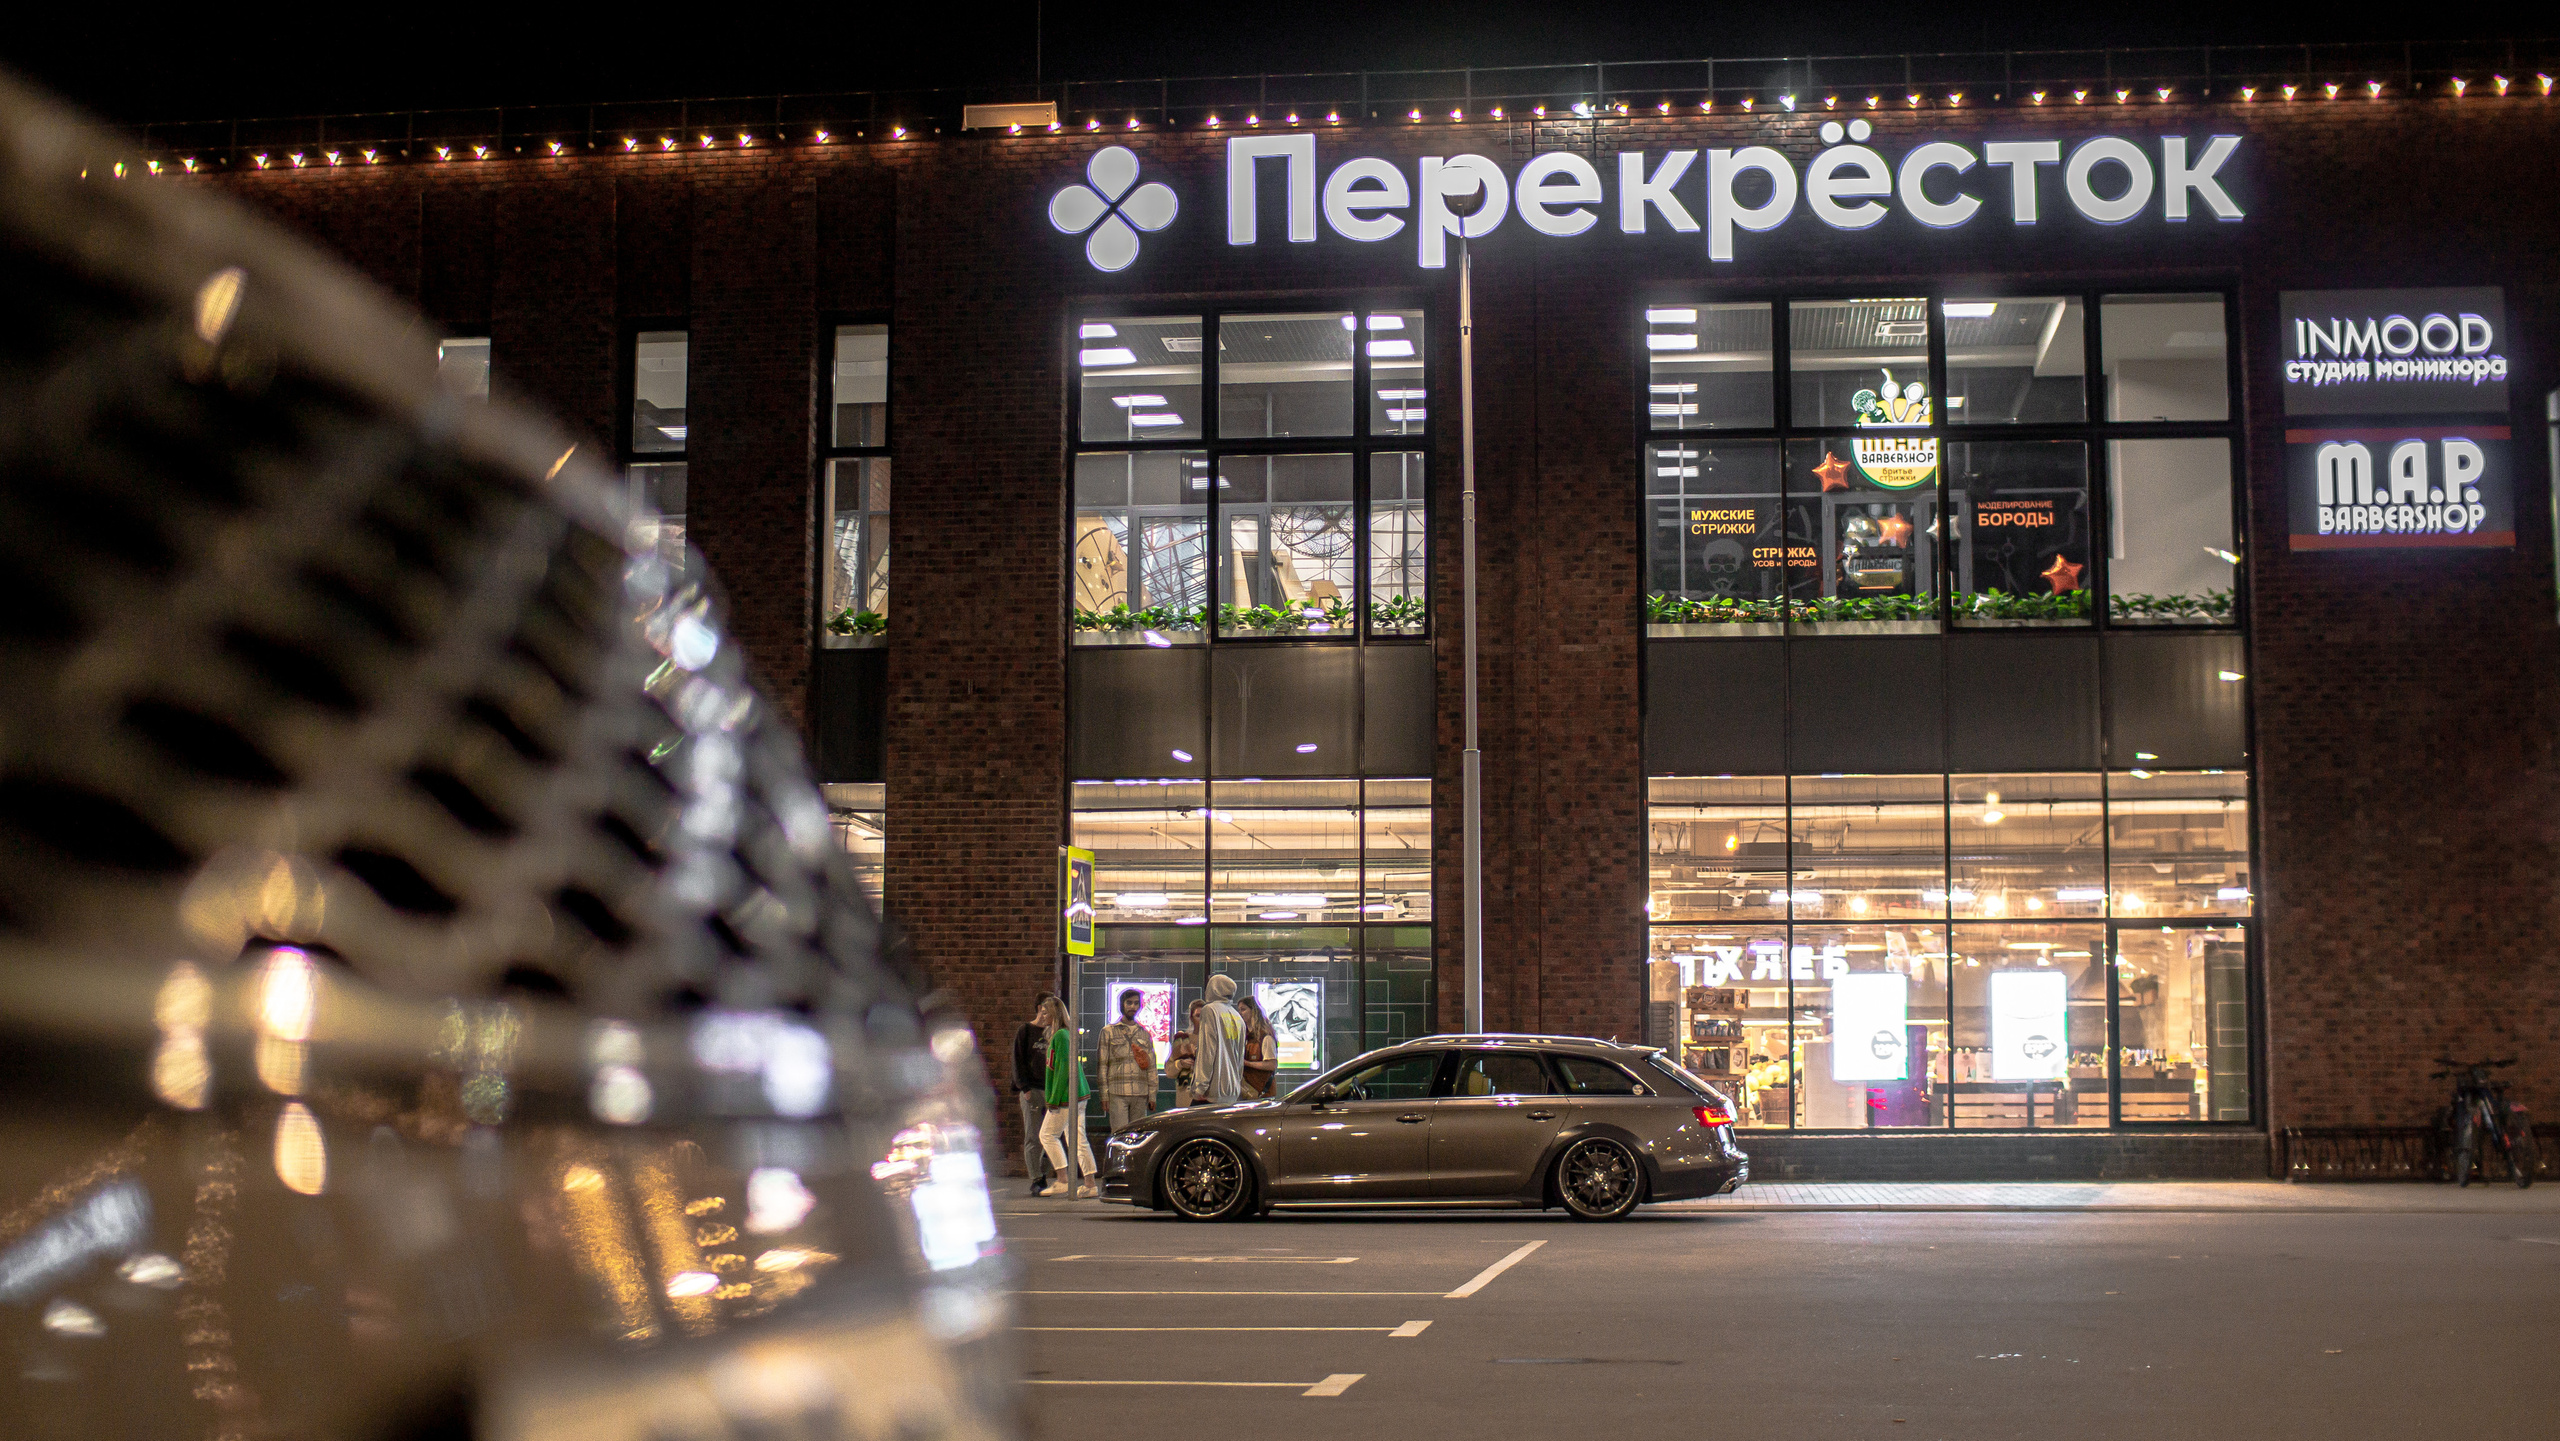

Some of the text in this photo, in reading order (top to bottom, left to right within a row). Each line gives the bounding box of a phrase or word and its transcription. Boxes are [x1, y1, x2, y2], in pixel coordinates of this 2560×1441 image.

[1225, 118, 2246, 270] Перекрёсток
[2295, 314, 2493, 357] INMOOD
[2285, 354, 2507, 387] студия маникюра
[1861, 452, 1934, 464] BARBERSHOP
[1882, 467, 1913, 476] бритье
[2316, 437, 2485, 506] M.A.P.
[1879, 474, 1916, 483] стрижки
[1977, 500, 2053, 510] МОДЕЛИРОВАНИЕ
[1691, 509, 1755, 521] МУЖСКИЕ
[1978, 512, 2054, 528] БОРОДЫ
[2318, 504, 2487, 534] BARBERSHOP
[1691, 523, 1755, 535] СТРИЖКИ
[1786, 559, 1817, 567] ОРОДЫ
